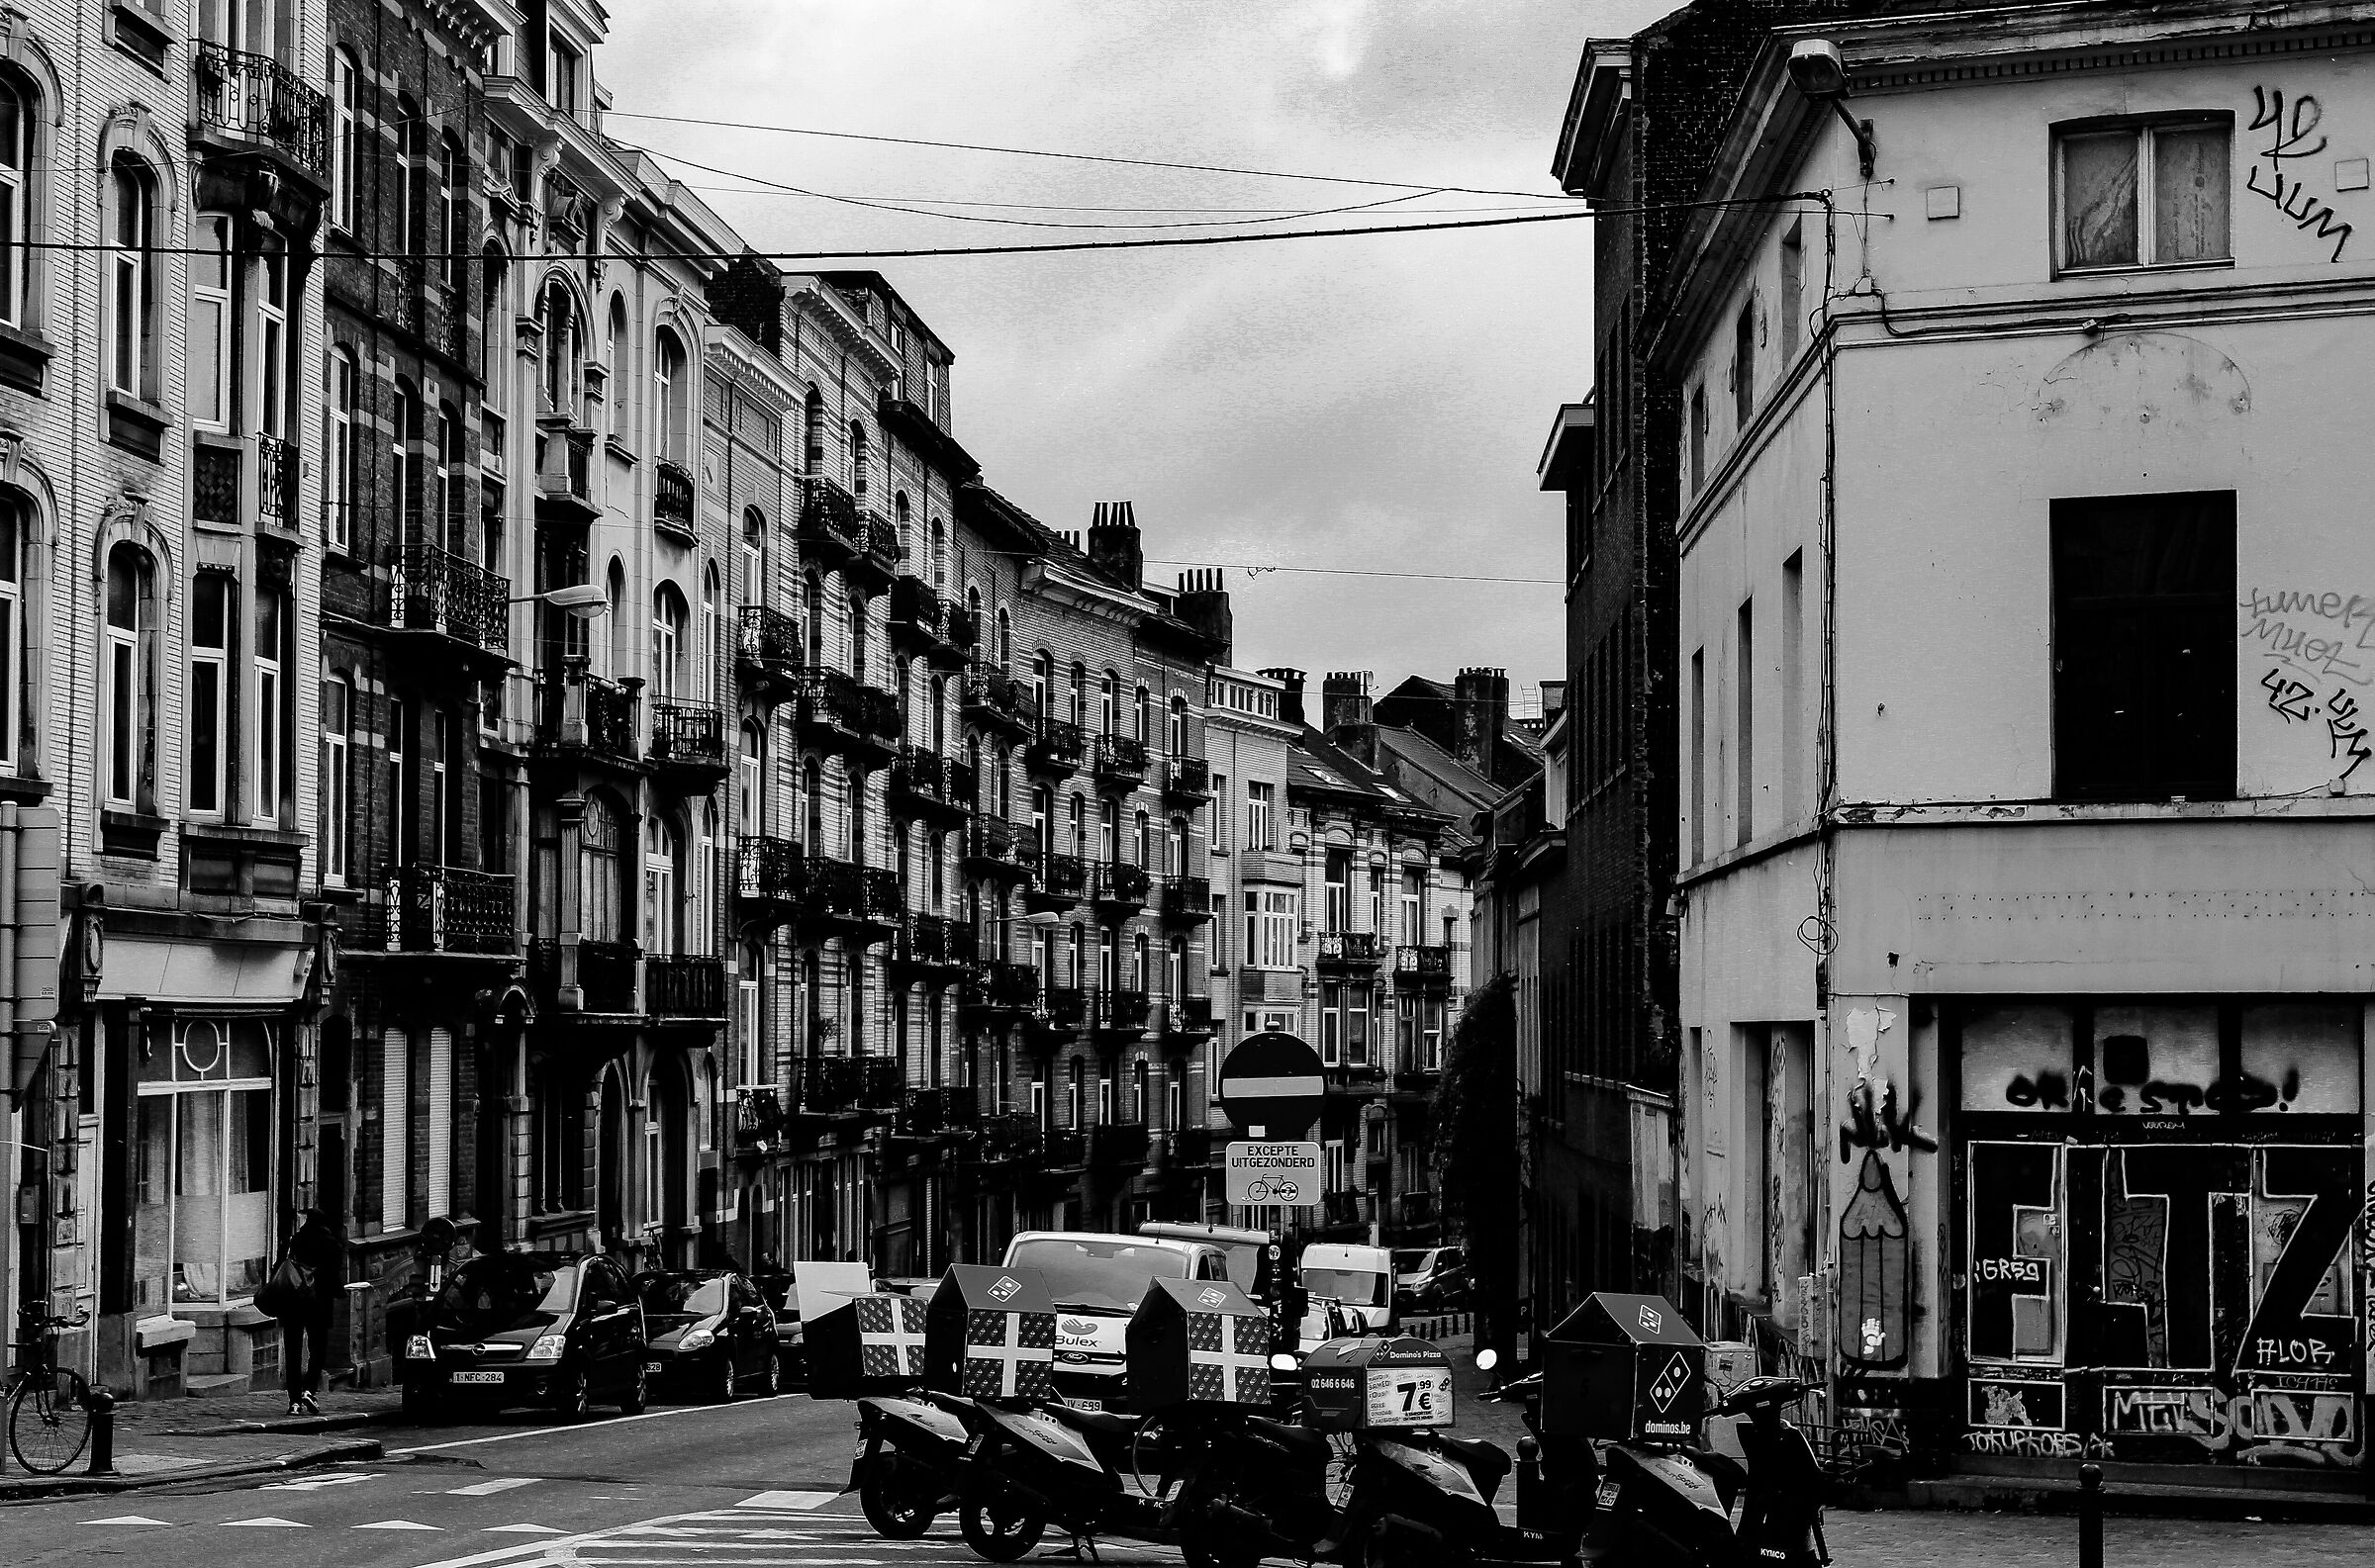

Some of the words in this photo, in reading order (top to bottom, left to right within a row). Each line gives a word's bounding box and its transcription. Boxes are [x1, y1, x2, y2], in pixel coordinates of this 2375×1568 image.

[1247, 1146, 1299, 1156] EXCEPTE
[1231, 1157, 1315, 1168] UITGEZONDERD
[1055, 1335, 1098, 1348] Bulex
[1389, 1350, 1422, 1359] Domino's
[1423, 1349, 1442, 1358] Pizza
[1310, 1378, 1320, 1389] 02
[1321, 1378, 1334, 1389] 646
[1335, 1378, 1340, 1389] 6
[1341, 1378, 1355, 1389] 646
[1645, 1420, 1691, 1434] dominos.be
[1759, 1547, 1787, 1560] KYMCO
